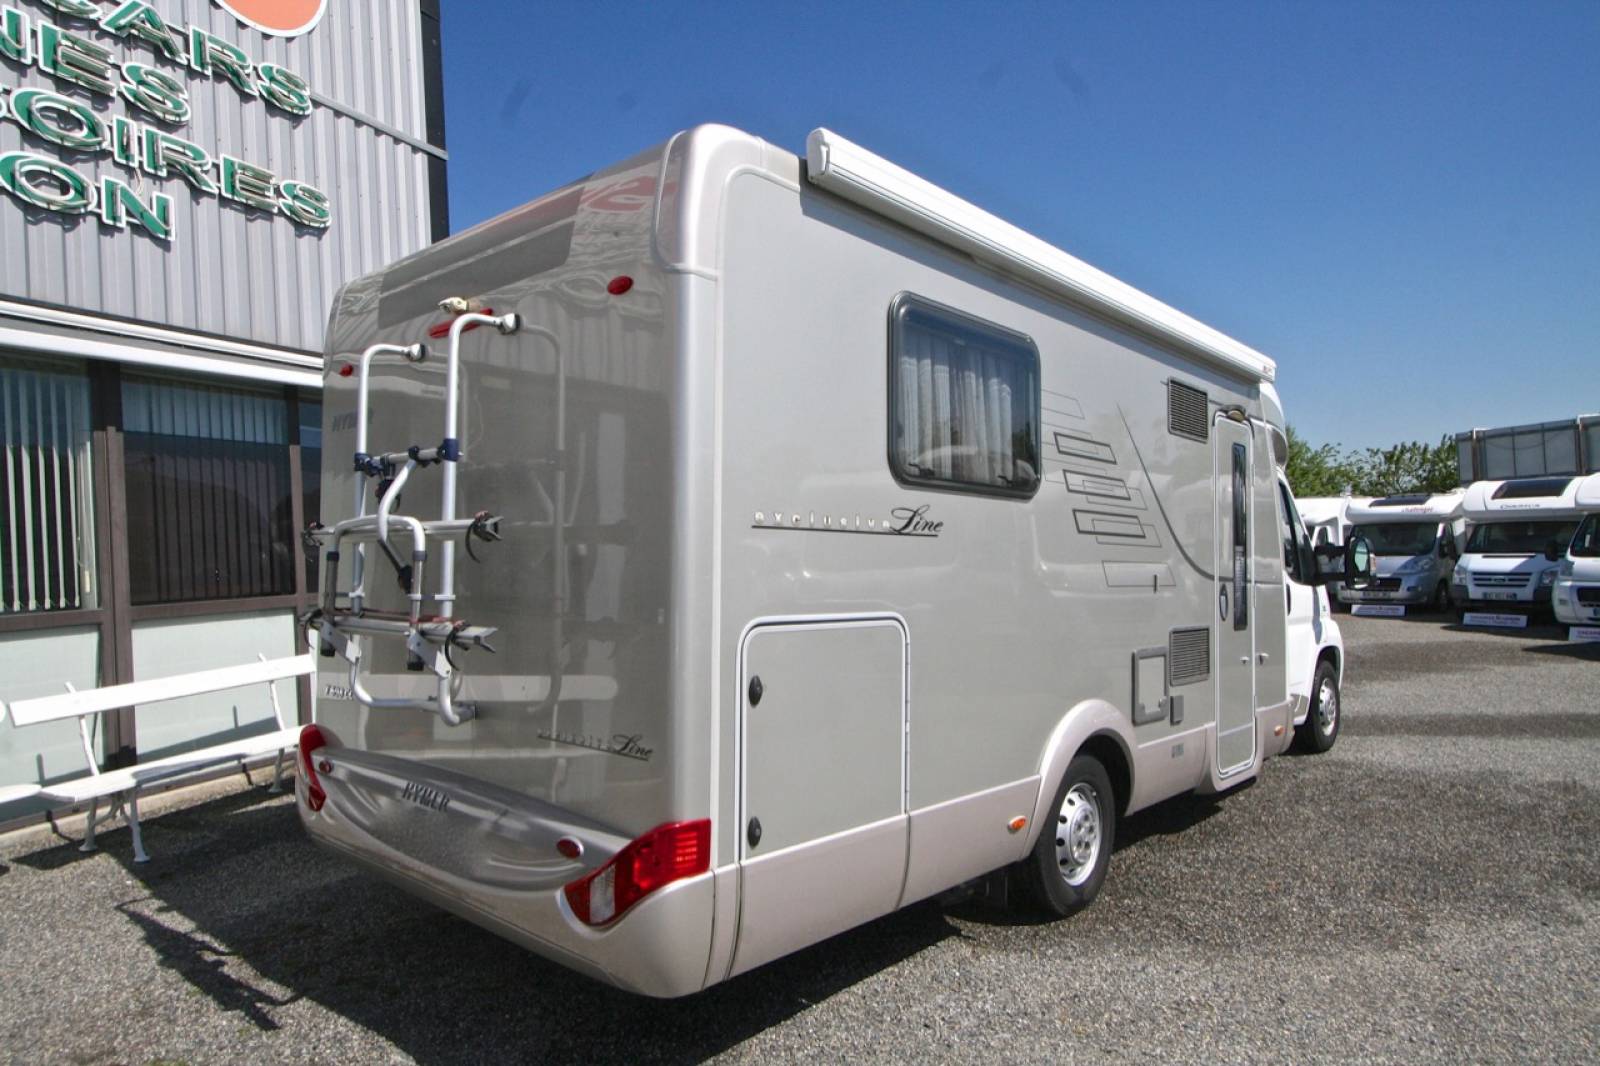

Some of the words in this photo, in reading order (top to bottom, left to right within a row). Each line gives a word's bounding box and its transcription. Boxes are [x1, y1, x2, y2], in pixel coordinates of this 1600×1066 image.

[37, 0, 312, 116] ARS
[0, 87, 332, 229] OIRES
[889, 504, 944, 534] Line
